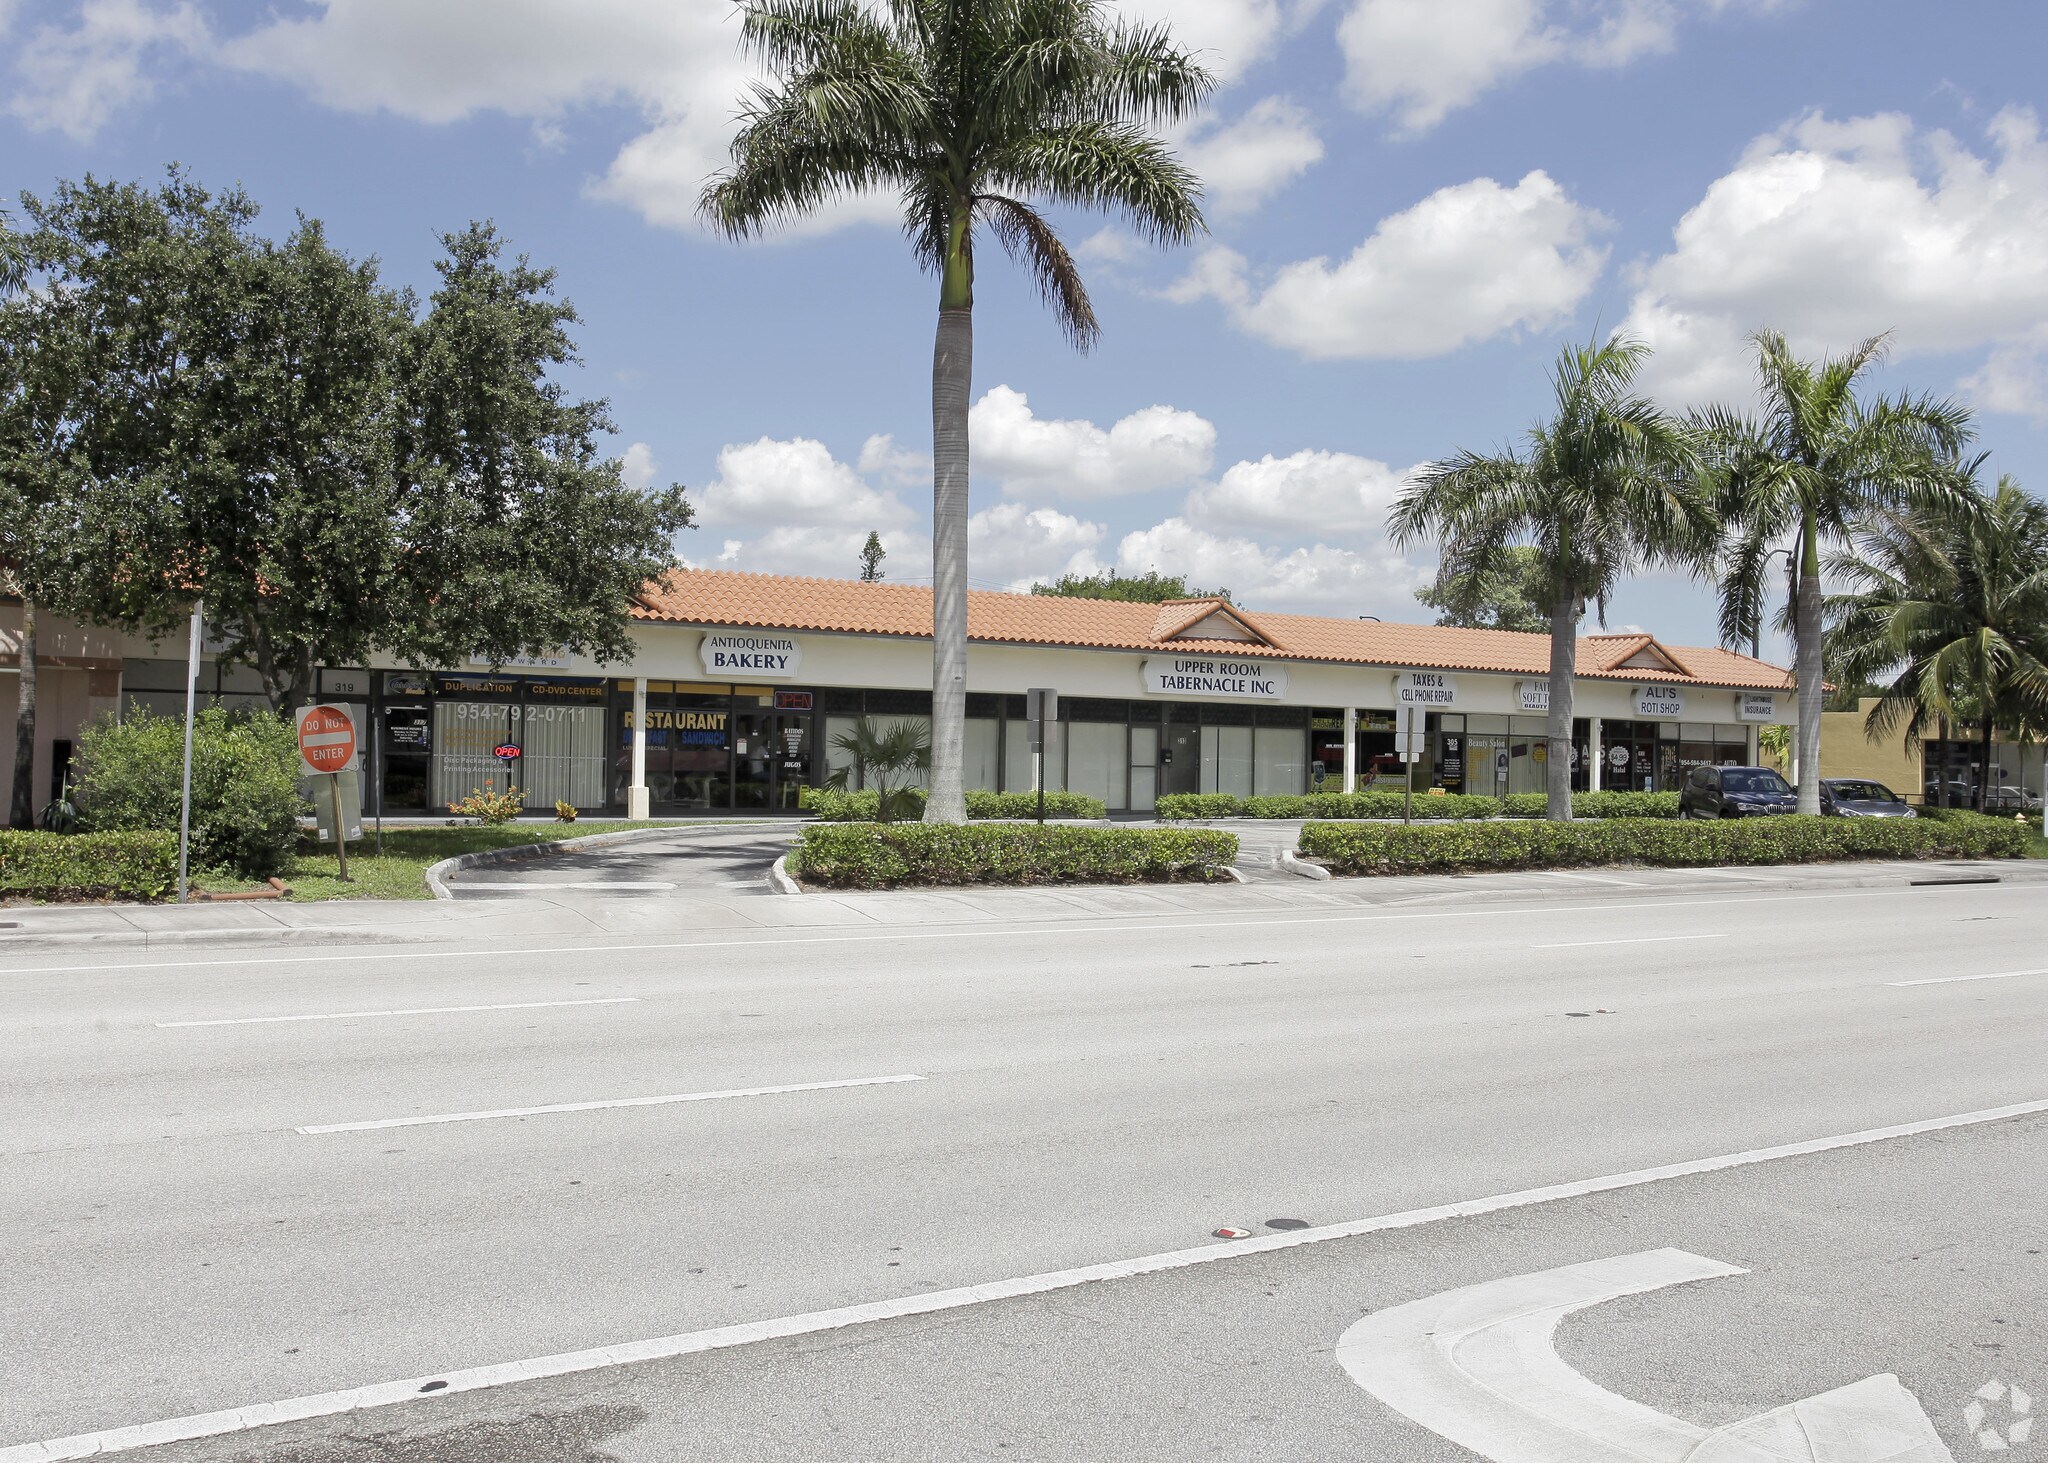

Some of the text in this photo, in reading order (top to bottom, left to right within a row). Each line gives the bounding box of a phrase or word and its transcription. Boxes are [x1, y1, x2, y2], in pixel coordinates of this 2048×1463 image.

[710, 636, 793, 651] ANTIOQUENITA
[714, 652, 788, 669] BAKERY
[1175, 660, 1261, 677] UPPER ROOM
[1160, 674, 1275, 695] TABERNACLE INC
[1412, 673, 1444, 687] TAXES &
[335, 682, 354, 692] 319
[445, 682, 513, 692] DUPLICATION
[532, 686, 602, 696] CD-DVD CENTER
[1645, 686, 1677, 699] ALI'S
[776, 693, 811, 708] OPEN
[1401, 688, 1454, 703] CELL PHONE REPAIR
[1522, 692, 1542, 703] SOFT
[457, 704, 586, 723] 954-792-0711
[1641, 702, 1680, 714] ROTI SHOP
[1744, 706, 1772, 715] INSURANCE
[306, 717, 345, 731] DO NOT
[624, 711, 727, 730] RSTAURANT
[1468, 738, 1506, 749] Beauty Salon
[312, 748, 344, 761] ENTER
[494, 746, 521, 757] OPEN
[1612, 766, 1626, 774] Halal
